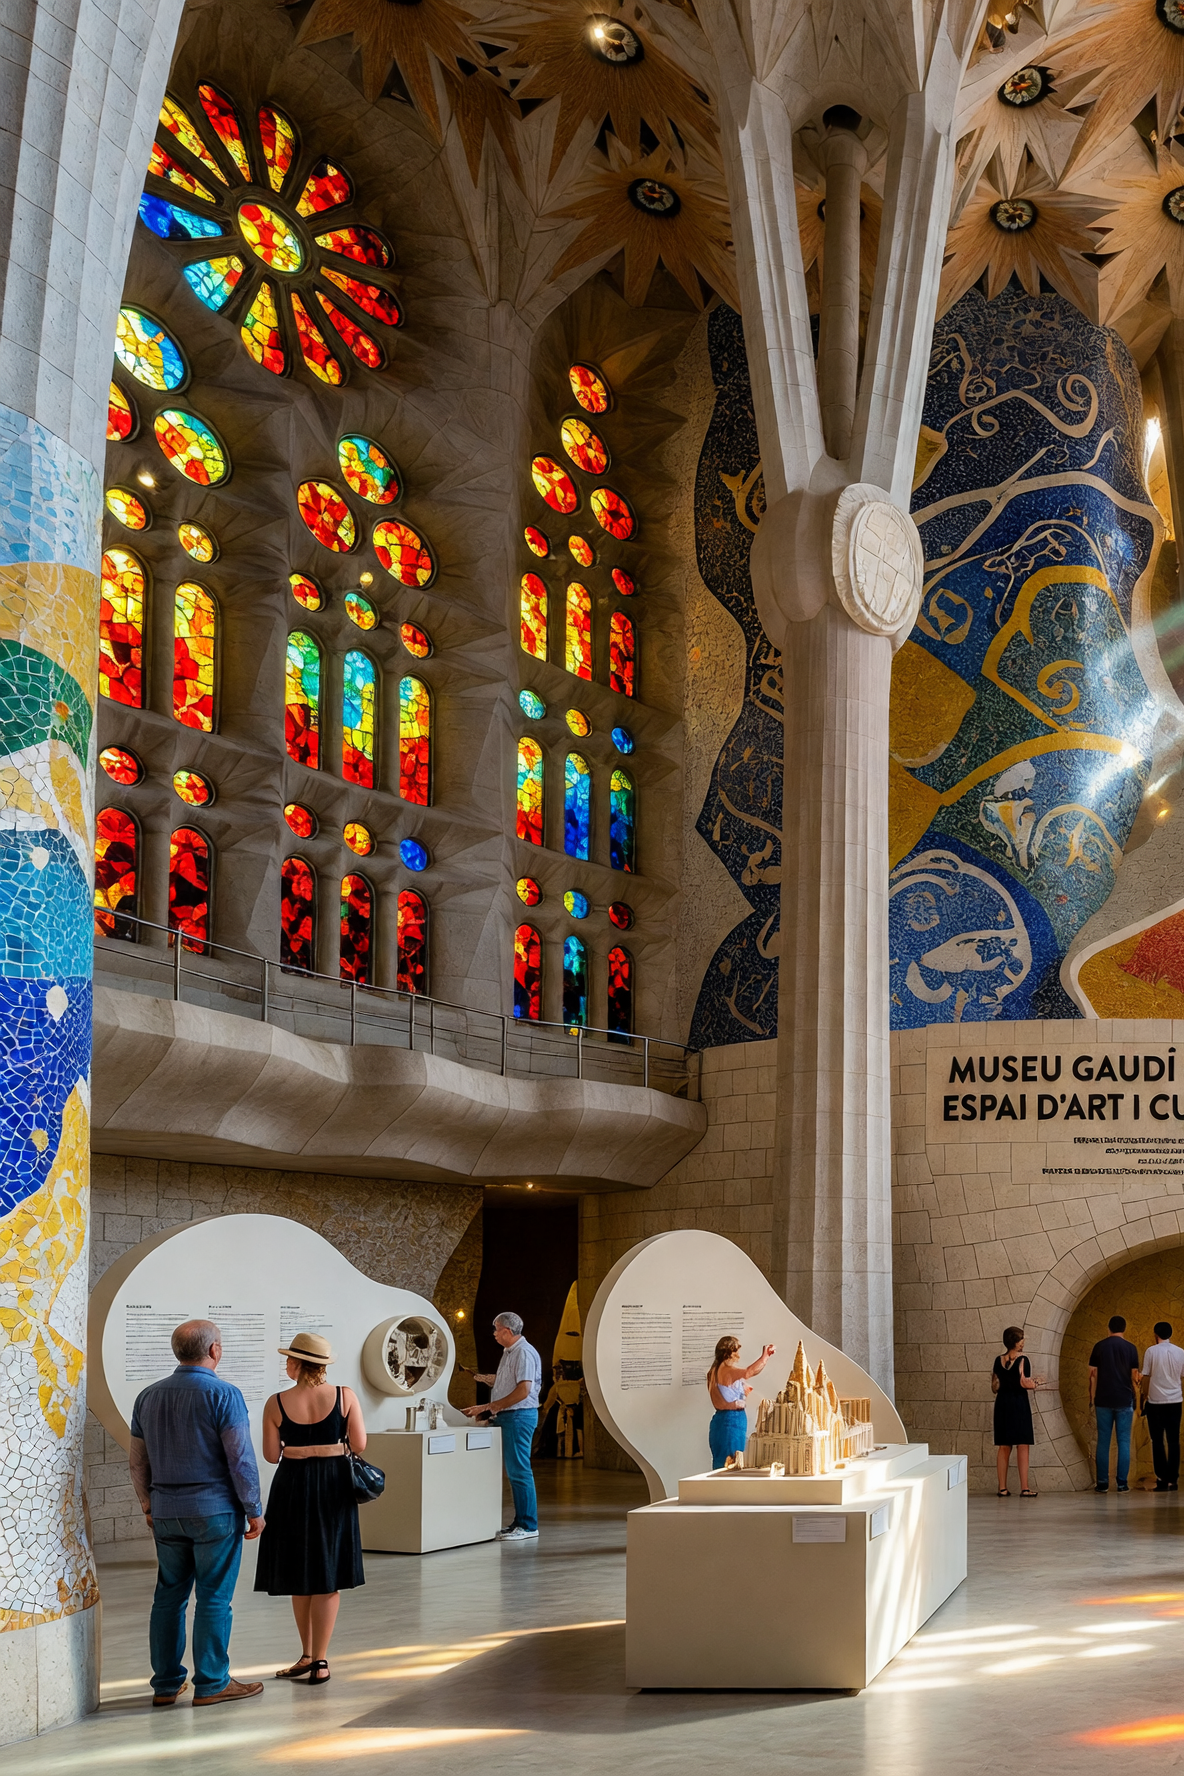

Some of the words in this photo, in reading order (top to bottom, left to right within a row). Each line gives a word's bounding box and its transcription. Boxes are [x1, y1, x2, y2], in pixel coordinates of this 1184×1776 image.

[949, 1055, 1062, 1083] MUSEU
[943, 1094, 1027, 1122] ESPAI
[1037, 1094, 1124, 1122] D'ART
[1133, 1095, 1140, 1121] I
